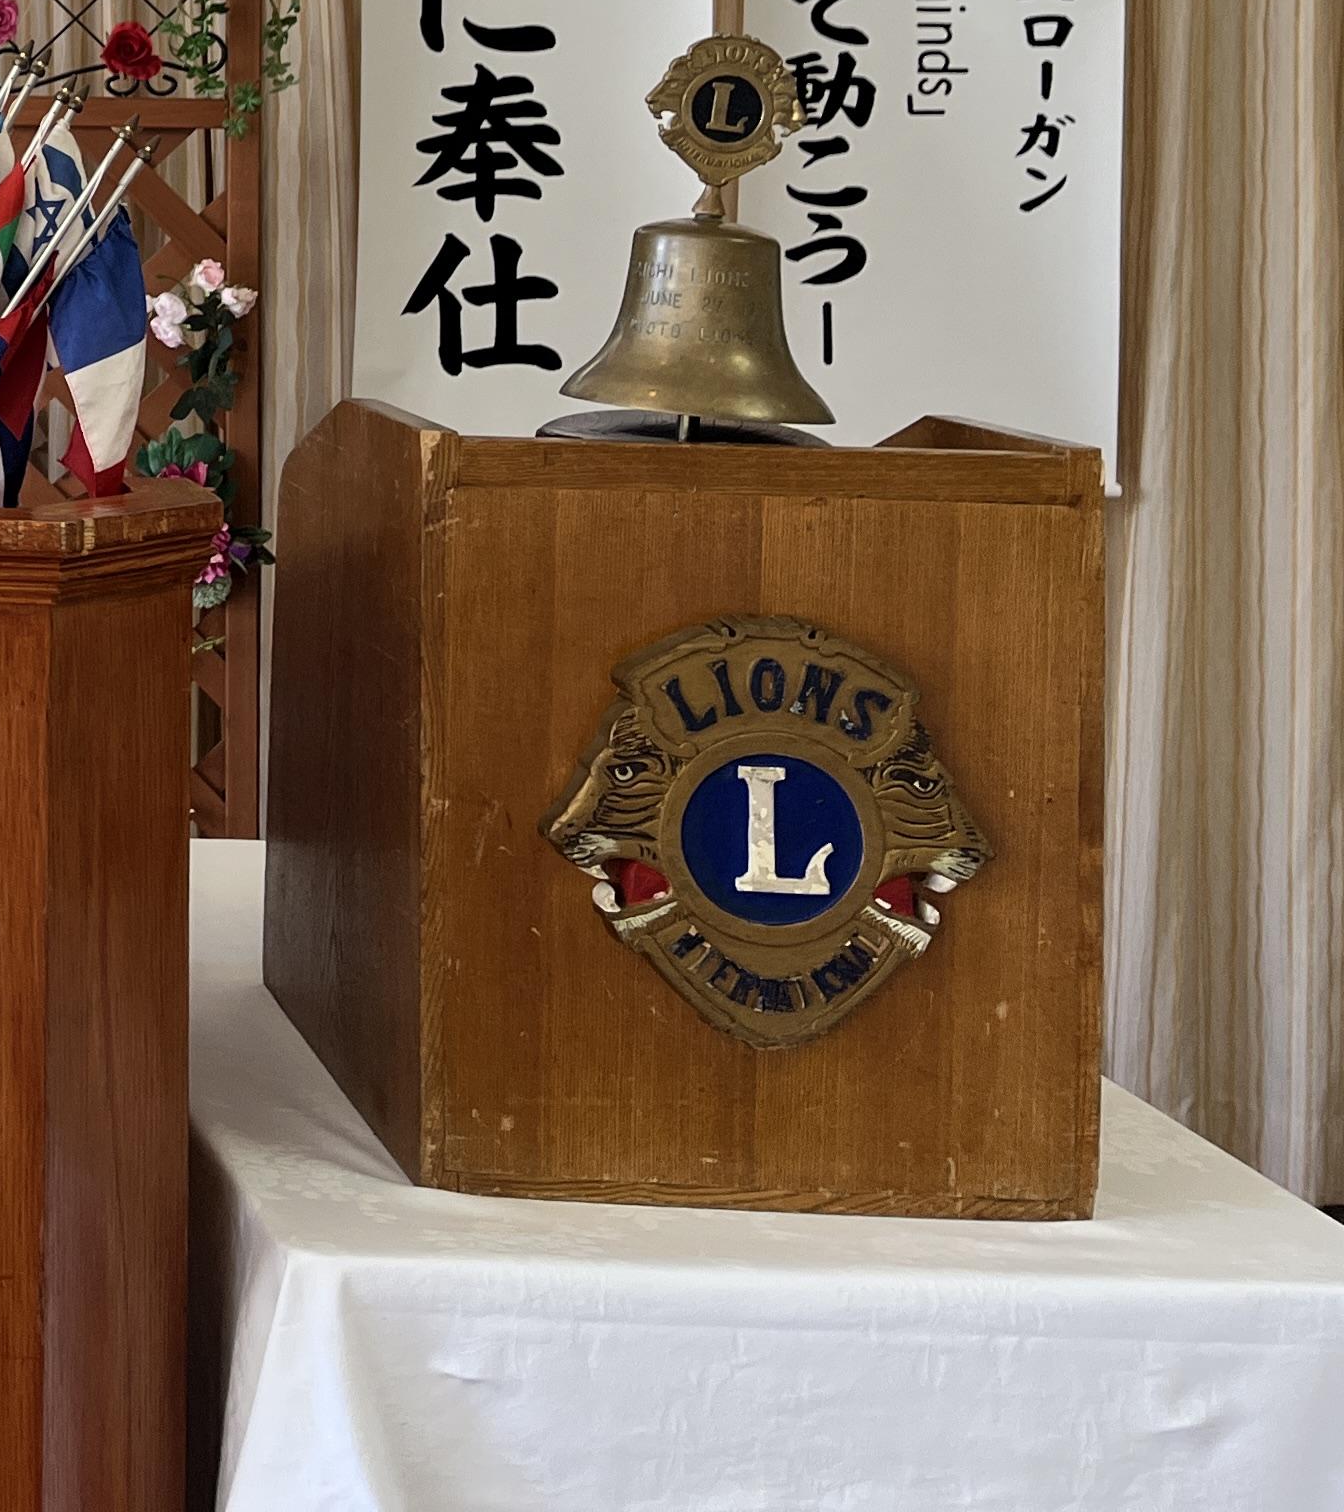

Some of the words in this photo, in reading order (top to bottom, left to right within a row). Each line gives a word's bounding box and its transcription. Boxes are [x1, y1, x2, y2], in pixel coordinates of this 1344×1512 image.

[705, 82, 749, 135] L
[662, 657, 894, 741] LIONS
[734, 764, 832, 896] L
